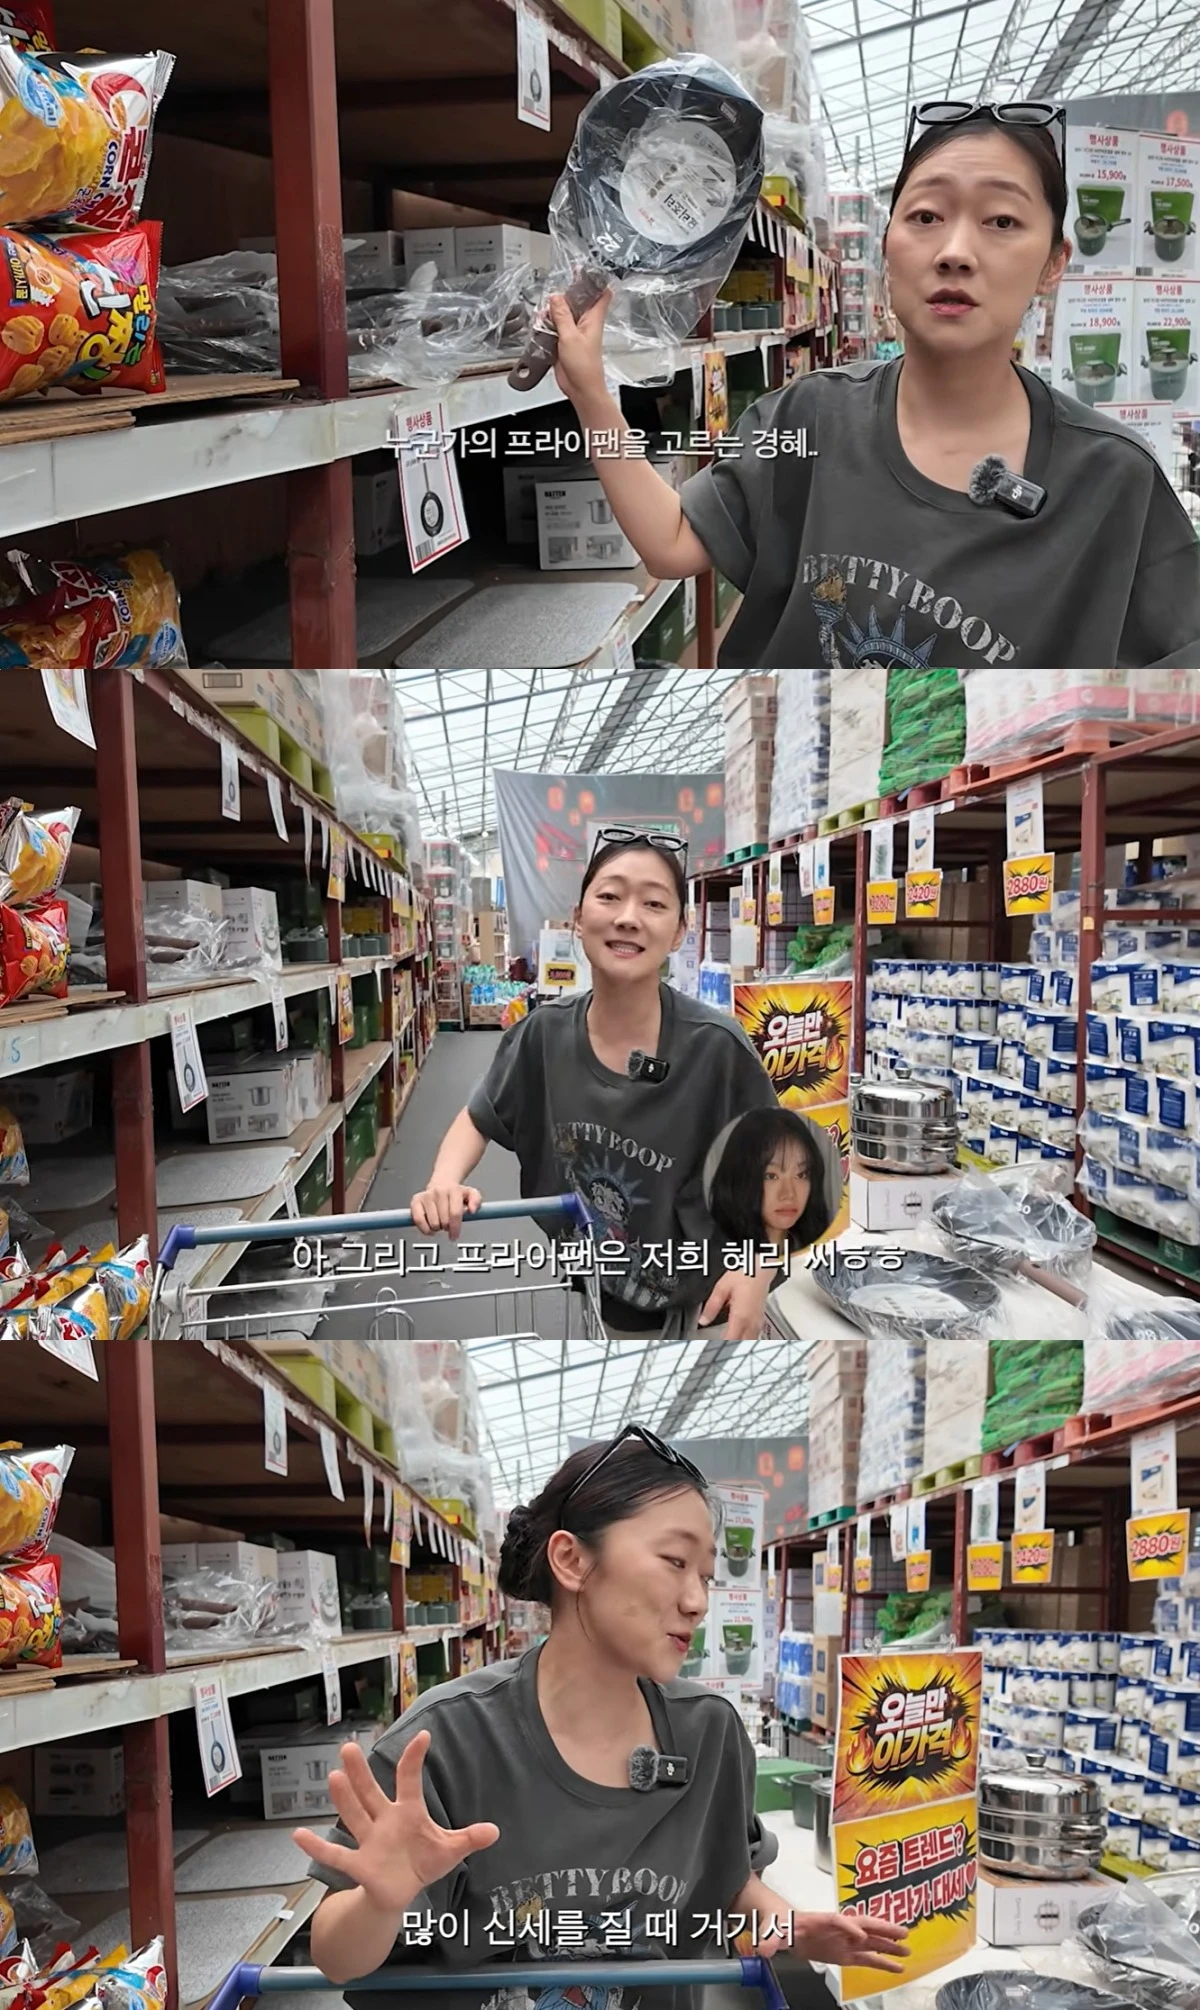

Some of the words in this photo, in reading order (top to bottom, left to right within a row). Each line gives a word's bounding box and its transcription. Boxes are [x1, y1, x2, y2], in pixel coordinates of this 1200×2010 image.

[1089, 133, 1119, 147] 행사상품
[1160, 142, 1186, 156] 행사상품
[99, 140, 119, 189] CORN
[1084, 284, 1113, 295] 행사상품
[1156, 285, 1183, 296] 행사상품
[115, 588, 132, 624] CORN
[907, 578, 1017, 665] BOOP
[1006, 873, 1049, 897] 2880원
[762, 1010, 824, 1051] 오늘만
[762, 1036, 829, 1081] 이가격
[608, 1130, 673, 1174] BOOP
[1131, 1532, 1183, 1558] 2880원
[874, 1686, 948, 1736] 오늘만
[872, 1718, 954, 1776] 이가격
[855, 1840, 900, 1888] 요즘
[901, 1822, 967, 1876] 트렌드?
[610, 1866, 689, 1905] BOOP
[930, 1863, 966, 1911] 대세
